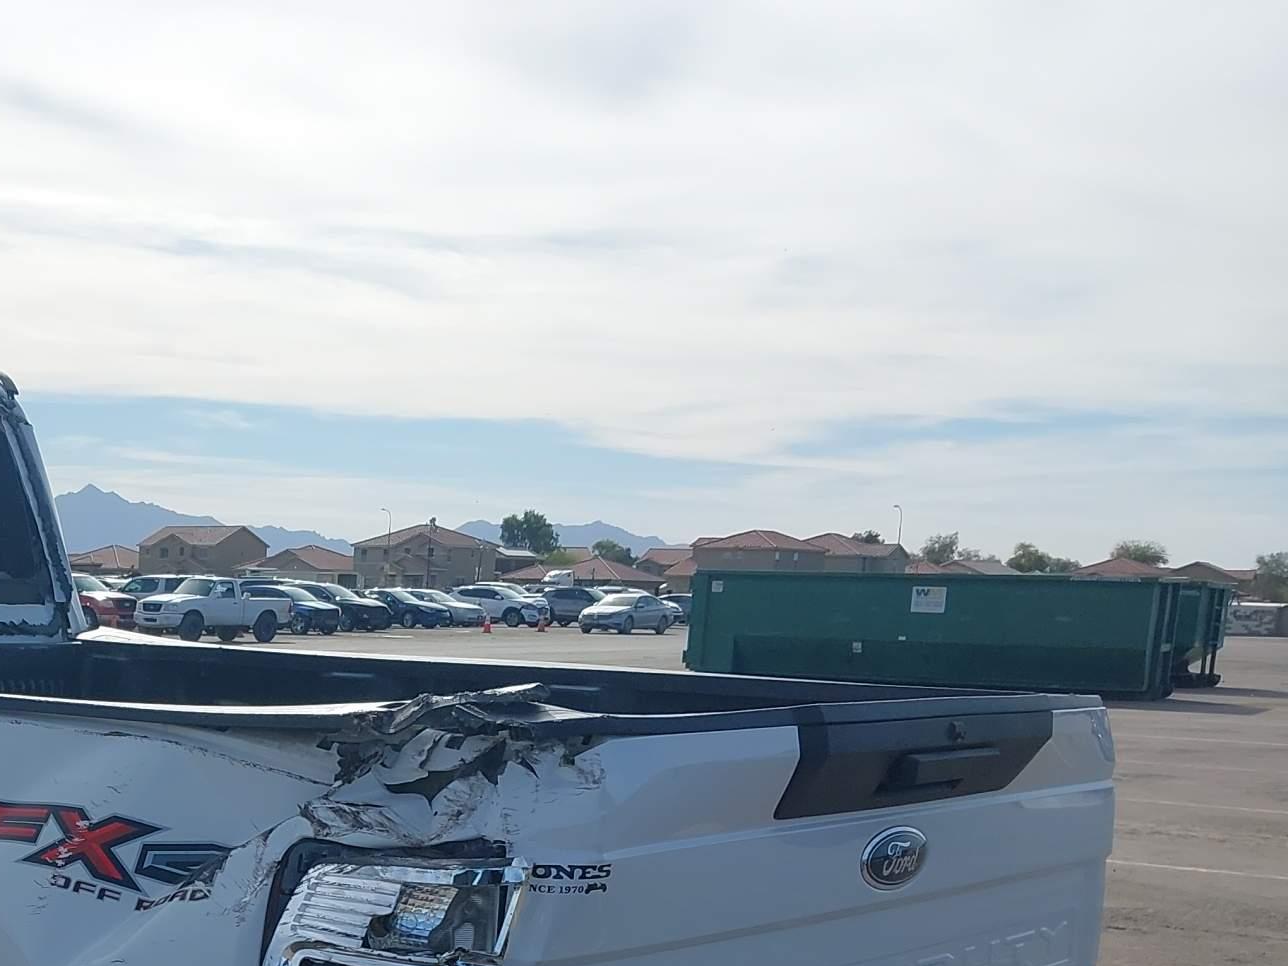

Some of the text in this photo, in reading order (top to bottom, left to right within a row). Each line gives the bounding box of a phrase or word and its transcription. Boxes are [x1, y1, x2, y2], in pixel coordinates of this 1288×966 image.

[883, 841, 920, 877] Ford
[532, 863, 612, 880] ONES
[49, 873, 122, 902] OFF
[529, 884, 585, 895] NCE 1970
